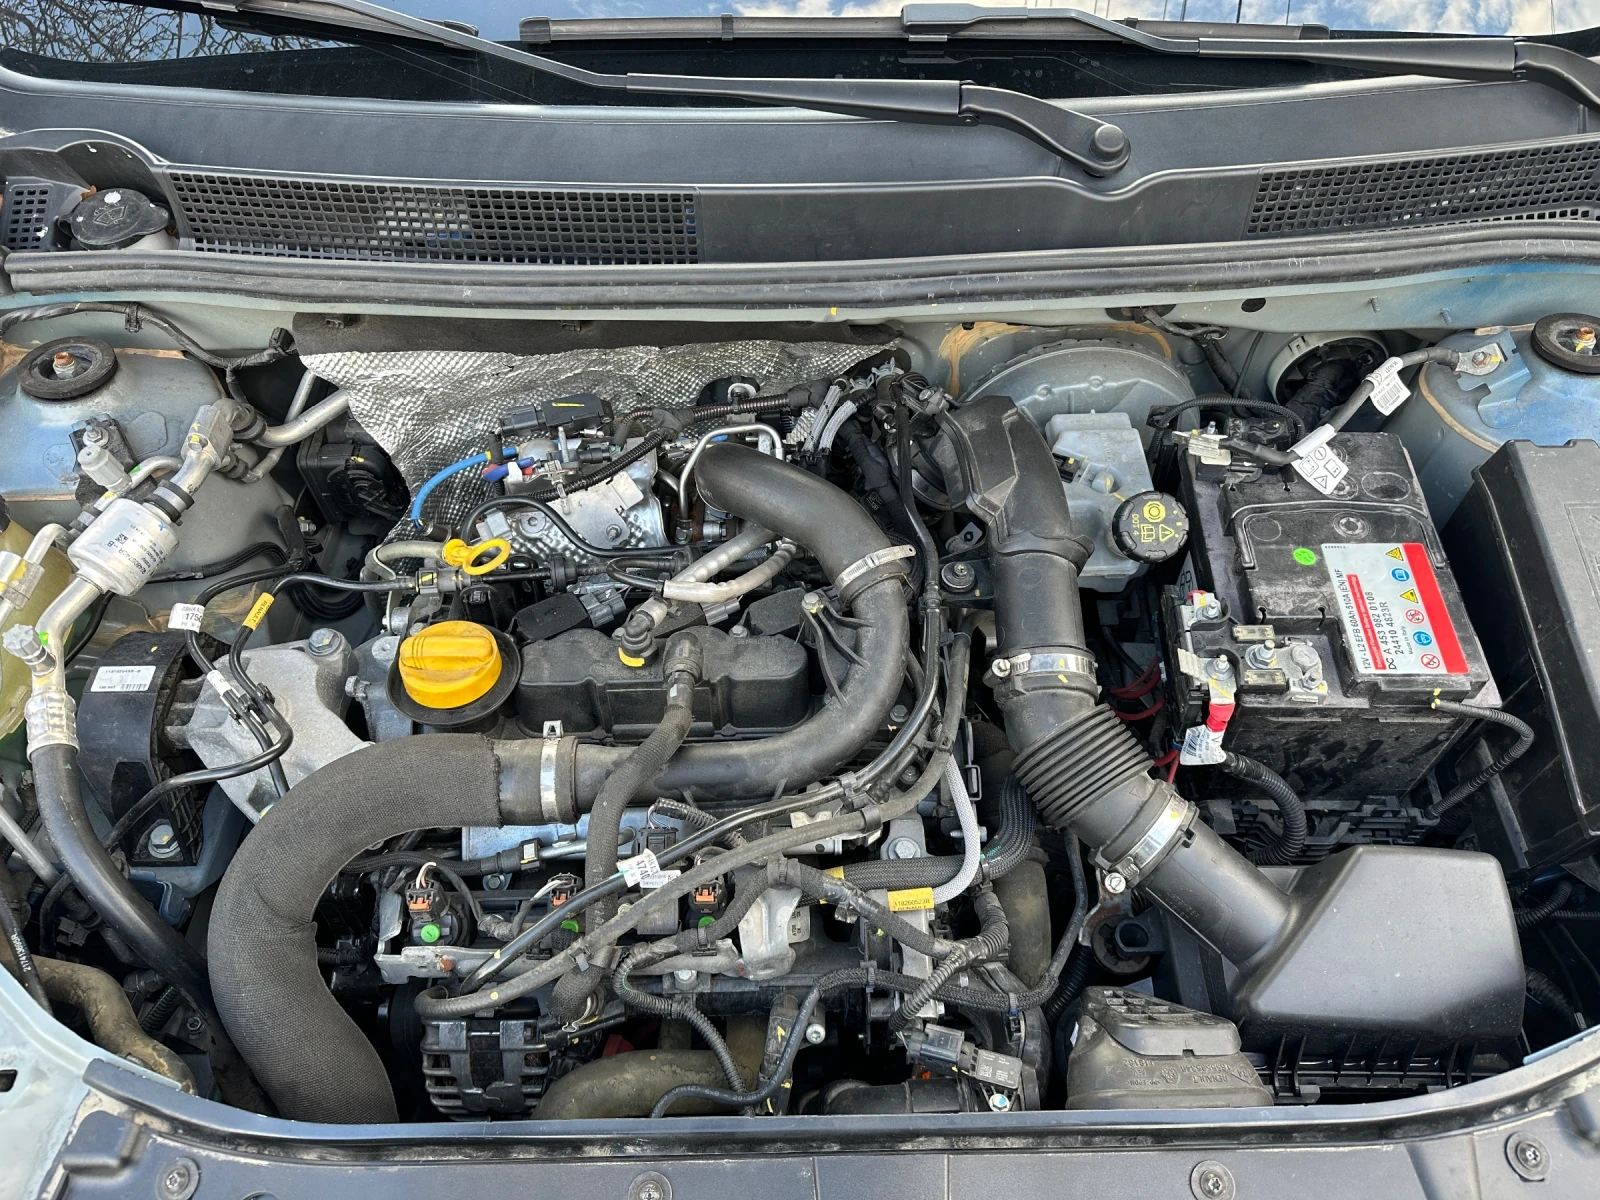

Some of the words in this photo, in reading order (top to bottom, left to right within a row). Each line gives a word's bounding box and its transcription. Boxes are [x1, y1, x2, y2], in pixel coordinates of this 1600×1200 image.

[1131, 513, 1140, 528] DOT
[1334, 568, 1344, 579] MF
[1342, 593, 1354, 610] 510A
[1347, 610, 1359, 628] 60Ah
[1371, 613, 1384, 628] 982
[1379, 601, 1395, 627] 4823R
[1352, 628, 1364, 643] EFB
[1377, 630, 1389, 645] 453
[1388, 629, 1404, 655] 24410
[1357, 643, 1367, 652] L2
[1361, 657, 1372, 670] 12V
[789, 1024, 801, 1045] MADE
[799, 1009, 807, 1020] IN
